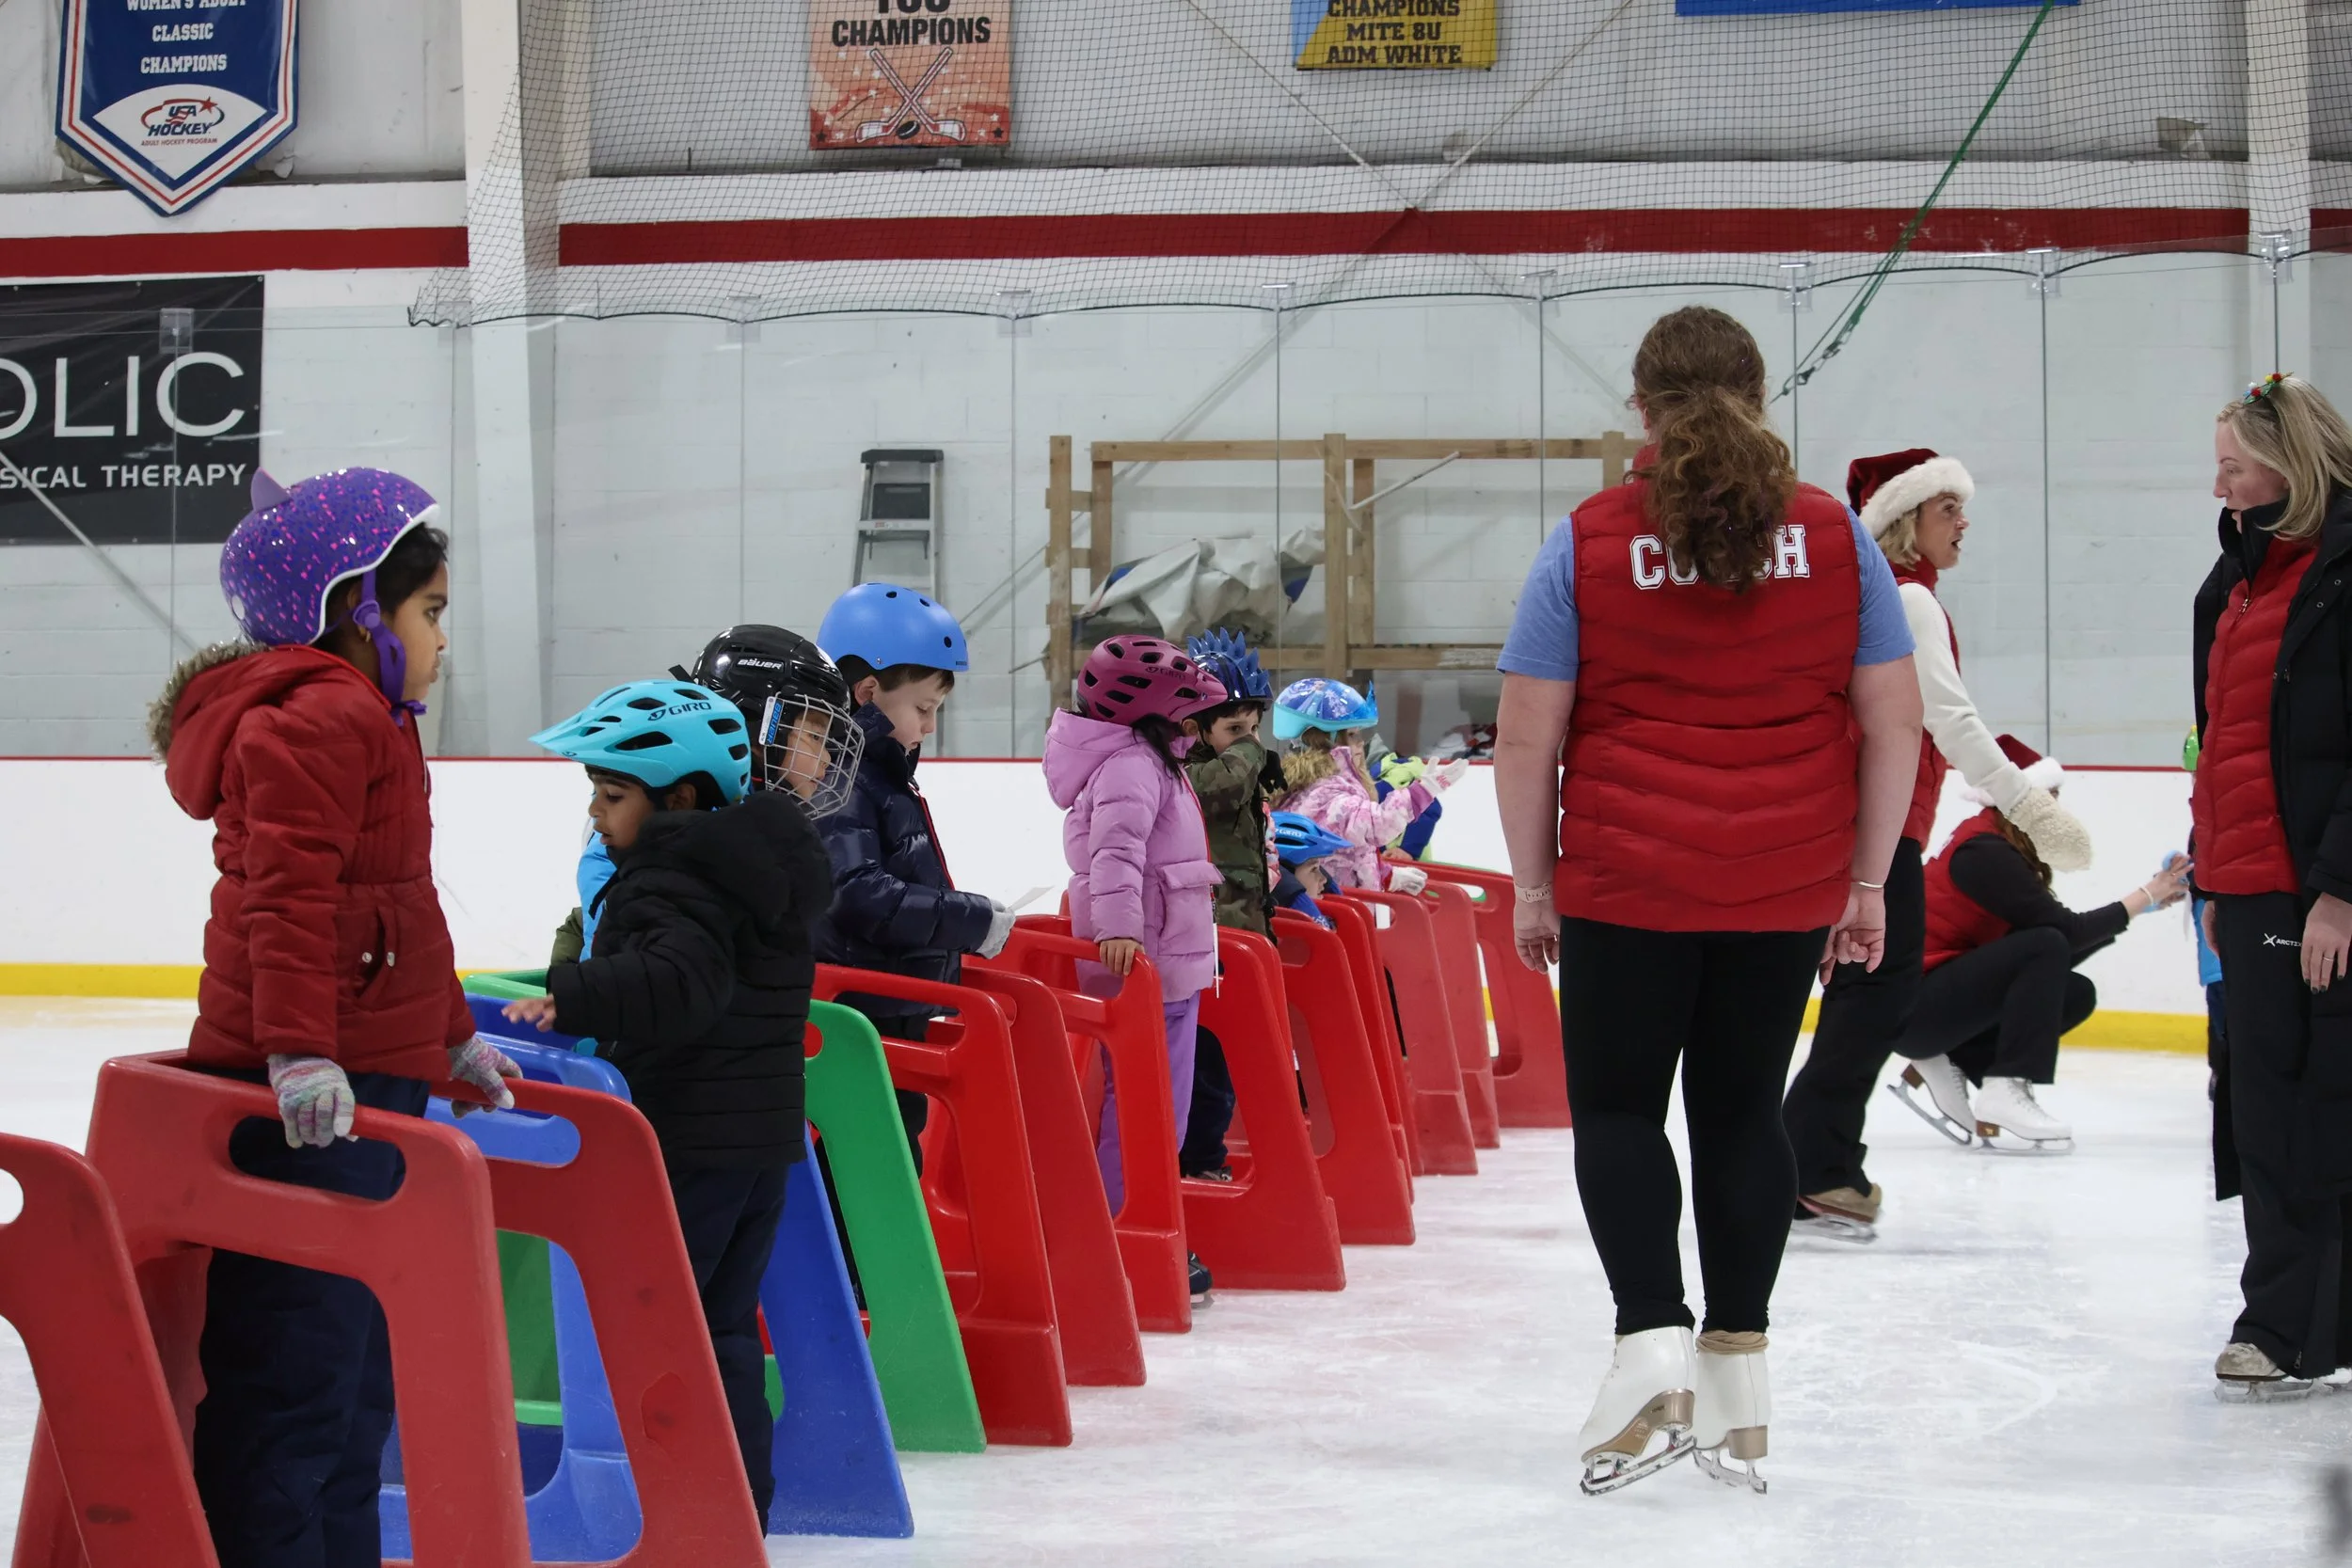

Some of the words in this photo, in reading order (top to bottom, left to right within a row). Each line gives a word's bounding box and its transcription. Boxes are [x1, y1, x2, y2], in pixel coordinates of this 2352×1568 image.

[126, 0, 195, 10] WOMENS
[1327, 0, 1461, 17] CHAMPIONS
[151, 23, 214, 41] CLASSIC
[832, 17, 991, 47] CHAMPIONS
[1346, 23, 1405, 40] MITE
[1412, 22, 1442, 40] 8U
[140, 54, 228, 73] CHAMPIONS
[1327, 45, 1377, 64] ADM
[1384, 45, 1462, 64] WHITE
[148, 121, 213, 136] HOCKEY
[101, 464, 246, 487] THERAPY
[1629, 525, 1810, 590] COH
[738, 658, 783, 670] BAUER
[669, 702, 711, 716] GIRO
